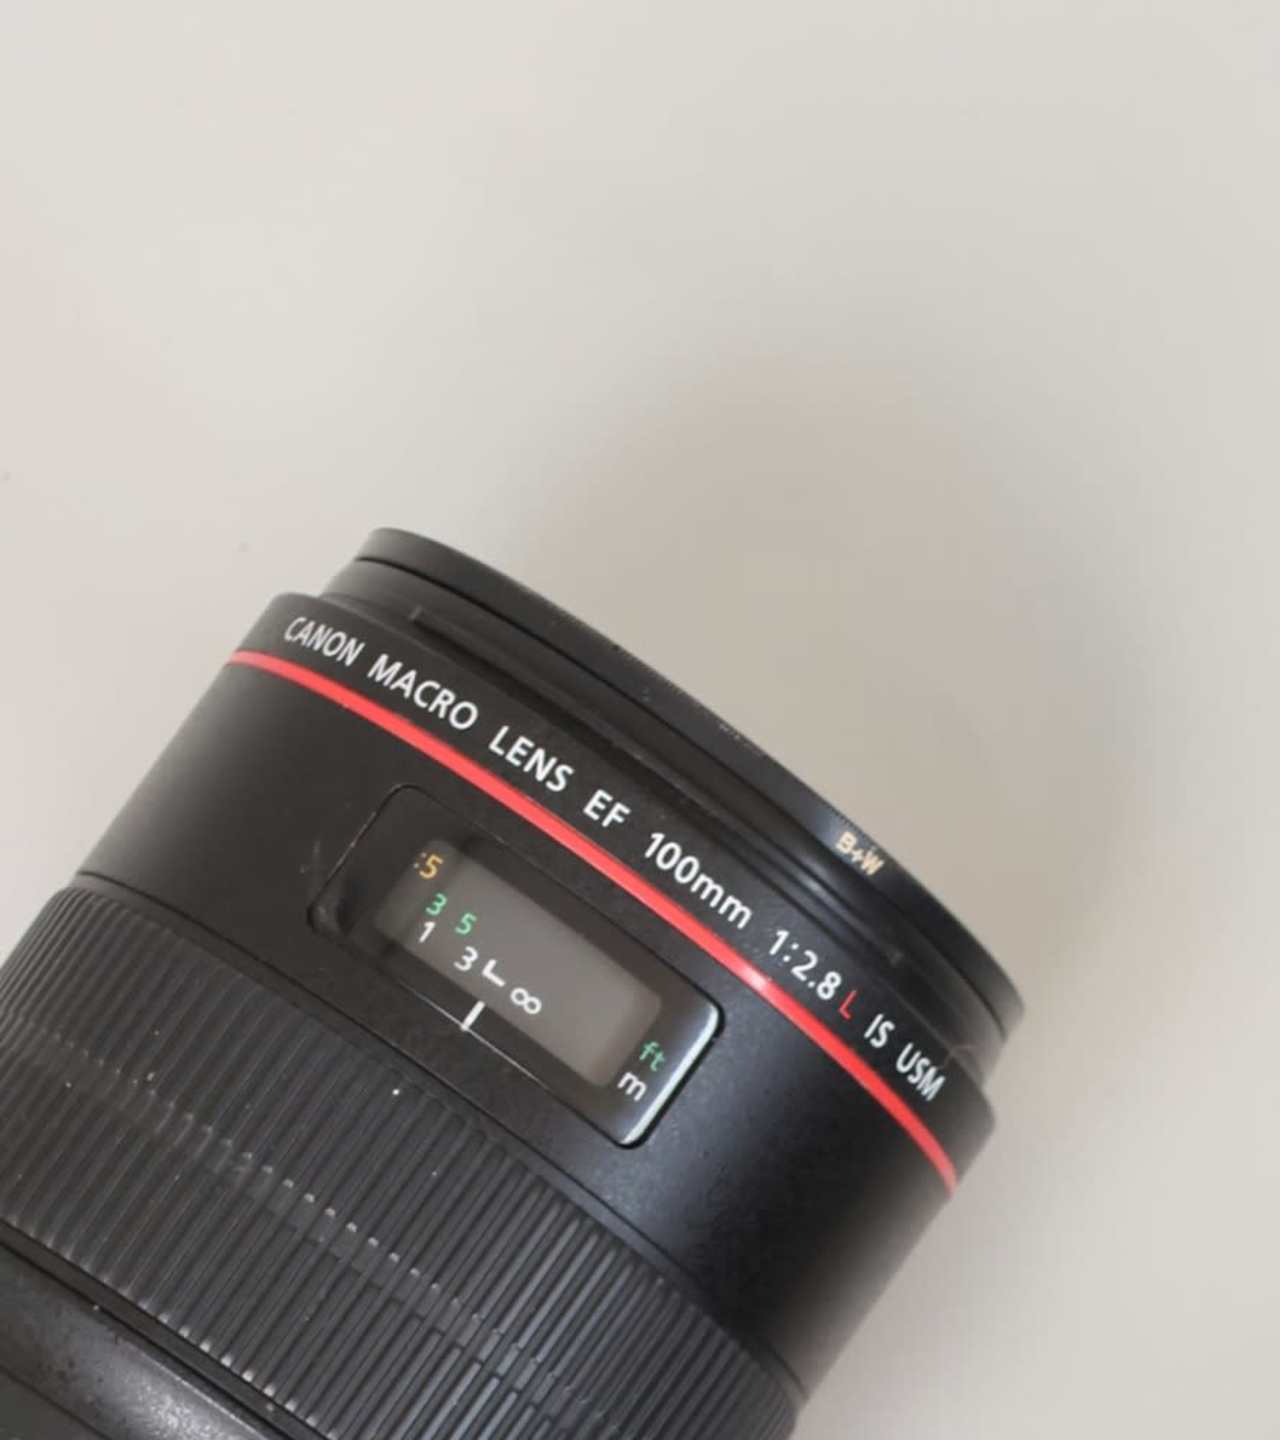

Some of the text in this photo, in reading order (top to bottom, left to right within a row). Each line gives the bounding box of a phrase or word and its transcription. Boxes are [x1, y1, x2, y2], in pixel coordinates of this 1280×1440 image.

[284, 617, 365, 667] CANON
[367, 654, 479, 730] MACRO
[488, 725, 574, 792] LENS
[583, 790, 631, 828] EF
[643, 832, 752, 930] 100mm
[767, 930, 842, 1001] 1:2.8
[863, 1014, 896, 1048] IS
[895, 1043, 945, 1101] USM
[835, 831, 885, 876] B+W
[418, 921, 435, 943] 1
[453, 946, 478, 972] 3
[617, 1072, 647, 1102] m
[426, 893, 665, 1071] 3 5 ft
